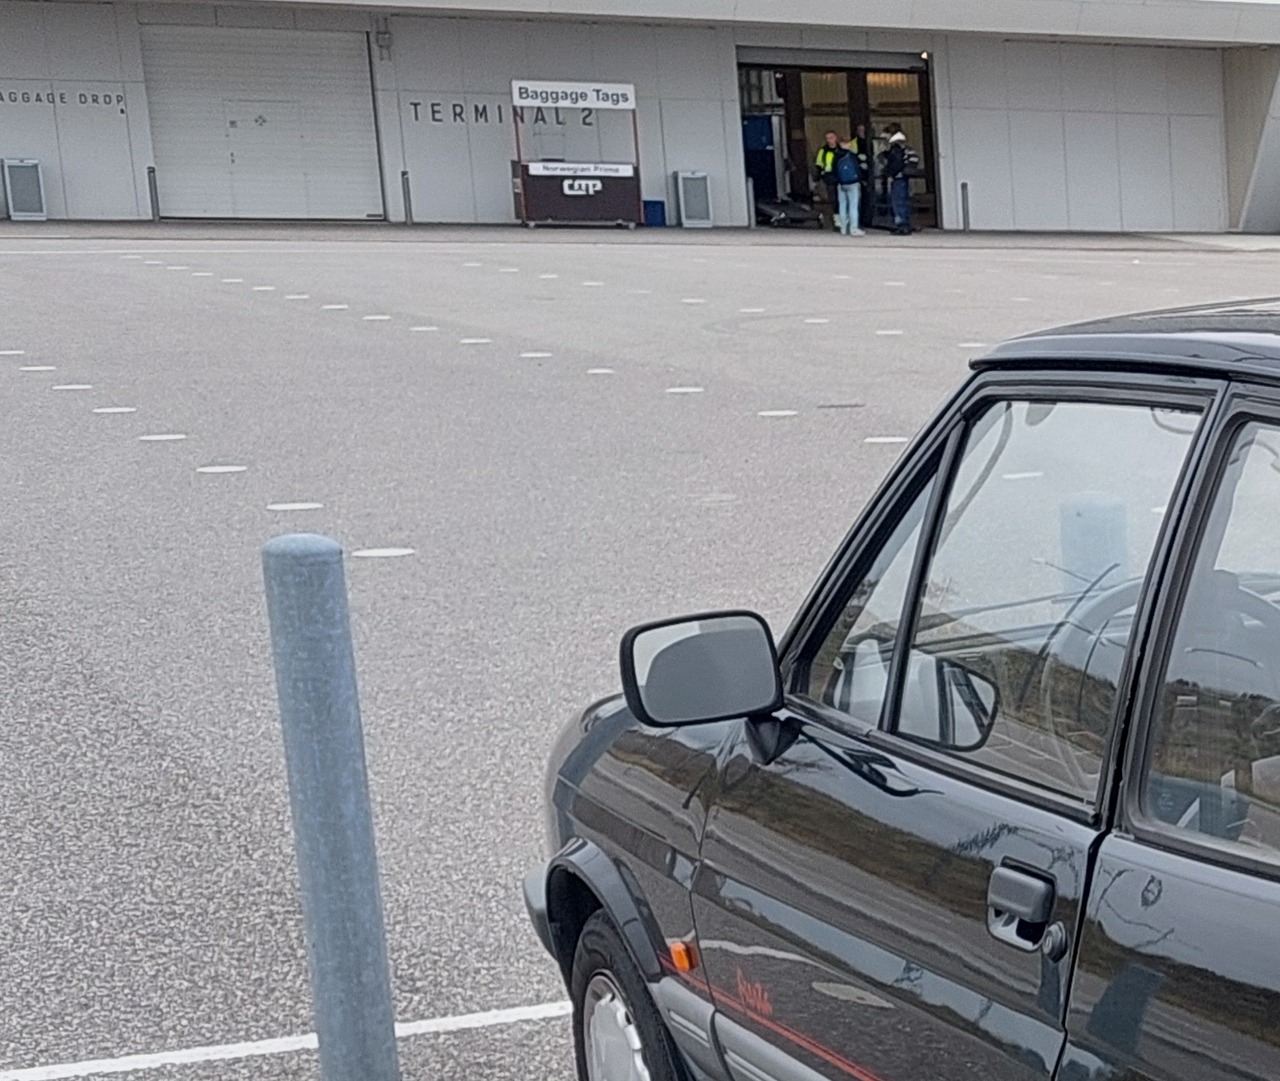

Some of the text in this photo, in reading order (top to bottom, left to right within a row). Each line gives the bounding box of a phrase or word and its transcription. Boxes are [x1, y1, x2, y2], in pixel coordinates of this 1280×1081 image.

[78, 93, 124, 105] DROP
[518, 86, 629, 106] Baggage Tags
[409, 102, 594, 126] TERMINAL 2
